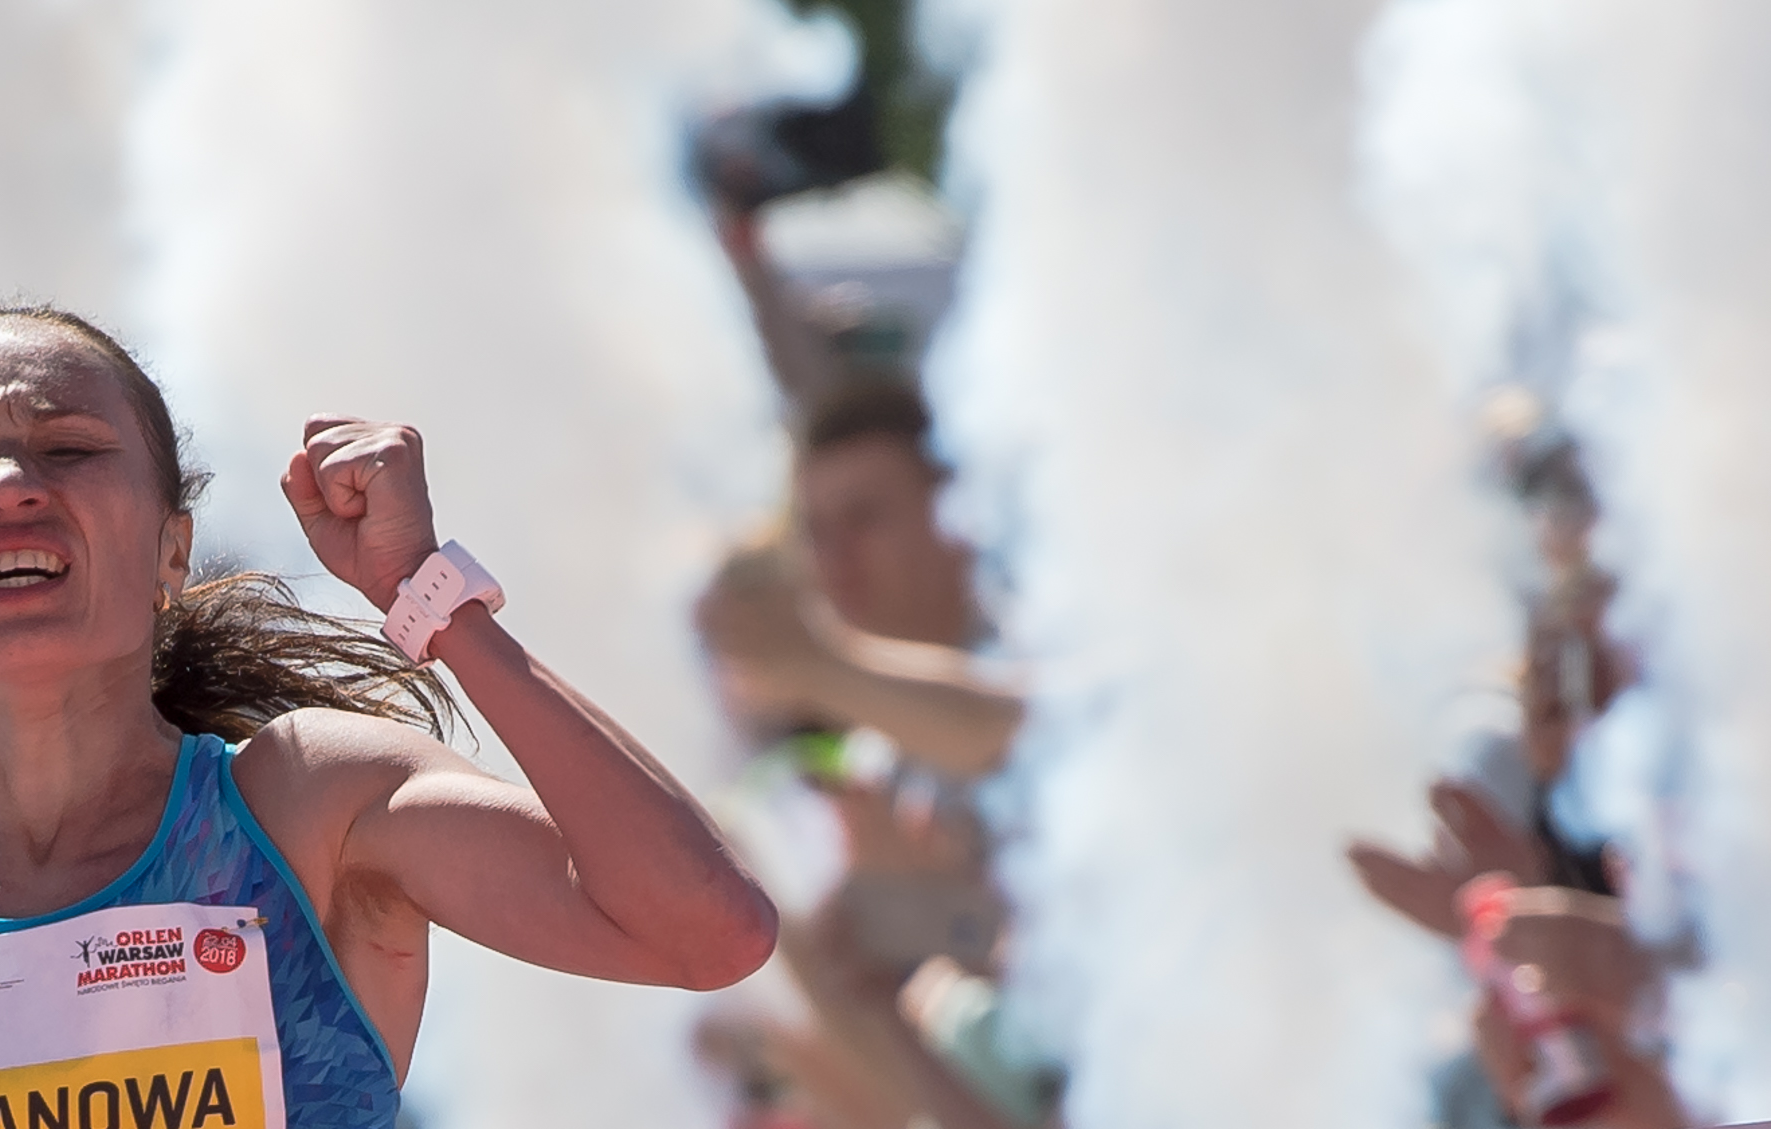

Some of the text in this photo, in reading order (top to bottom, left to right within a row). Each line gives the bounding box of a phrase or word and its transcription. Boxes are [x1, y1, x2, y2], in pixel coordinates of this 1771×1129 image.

[116, 927, 183, 946] ORLEN
[98, 943, 184, 966] WARSAW
[200, 947, 237, 967] 2018
[77, 958, 186, 988] MARATHON
